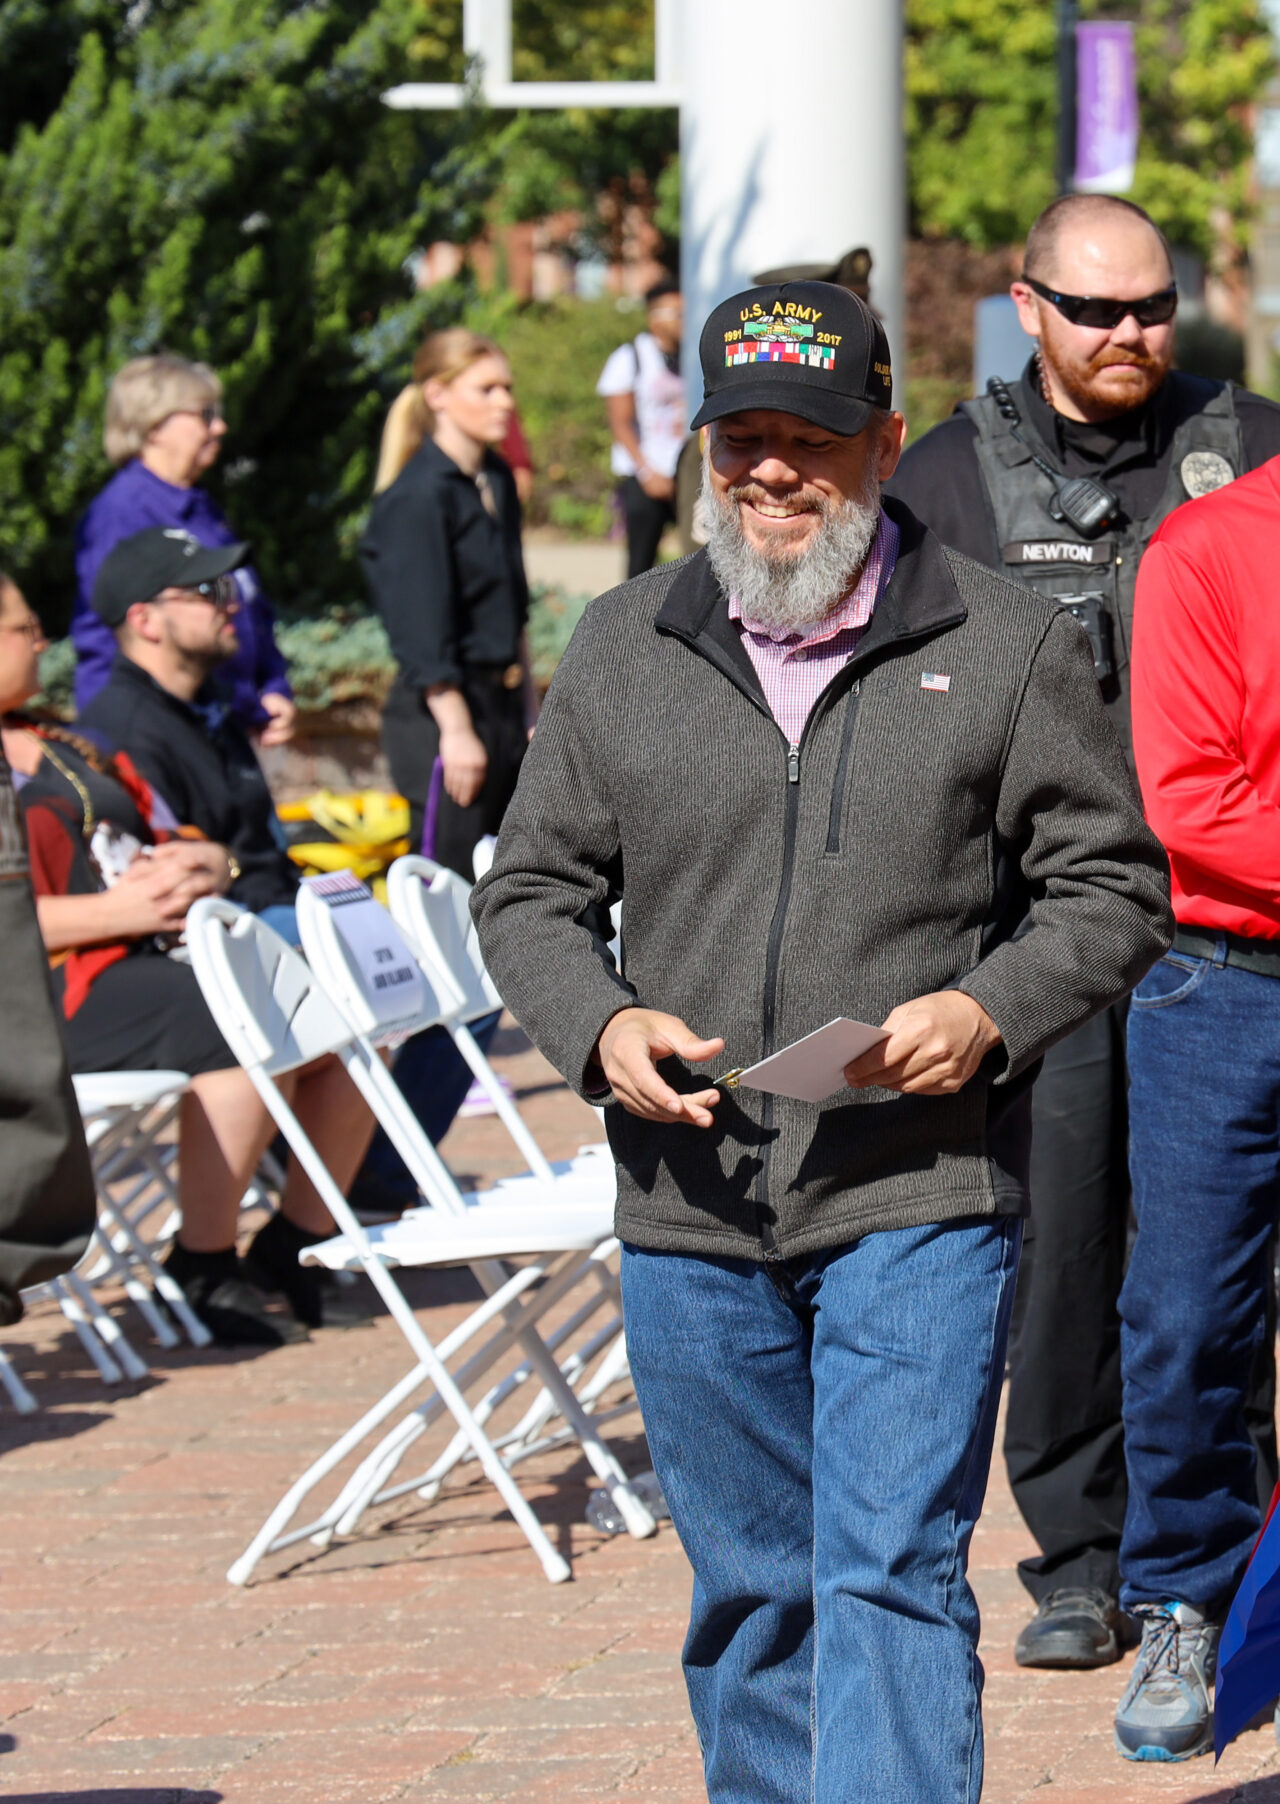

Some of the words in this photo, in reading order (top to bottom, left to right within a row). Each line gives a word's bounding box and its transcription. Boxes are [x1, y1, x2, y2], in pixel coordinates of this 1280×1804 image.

[739, 303, 766, 322] U.S.
[772, 301, 823, 323] ARMY
[723, 328, 742, 343] 1991
[816, 332, 843, 347] 2017
[1022, 543, 1093, 562] NEWTON
